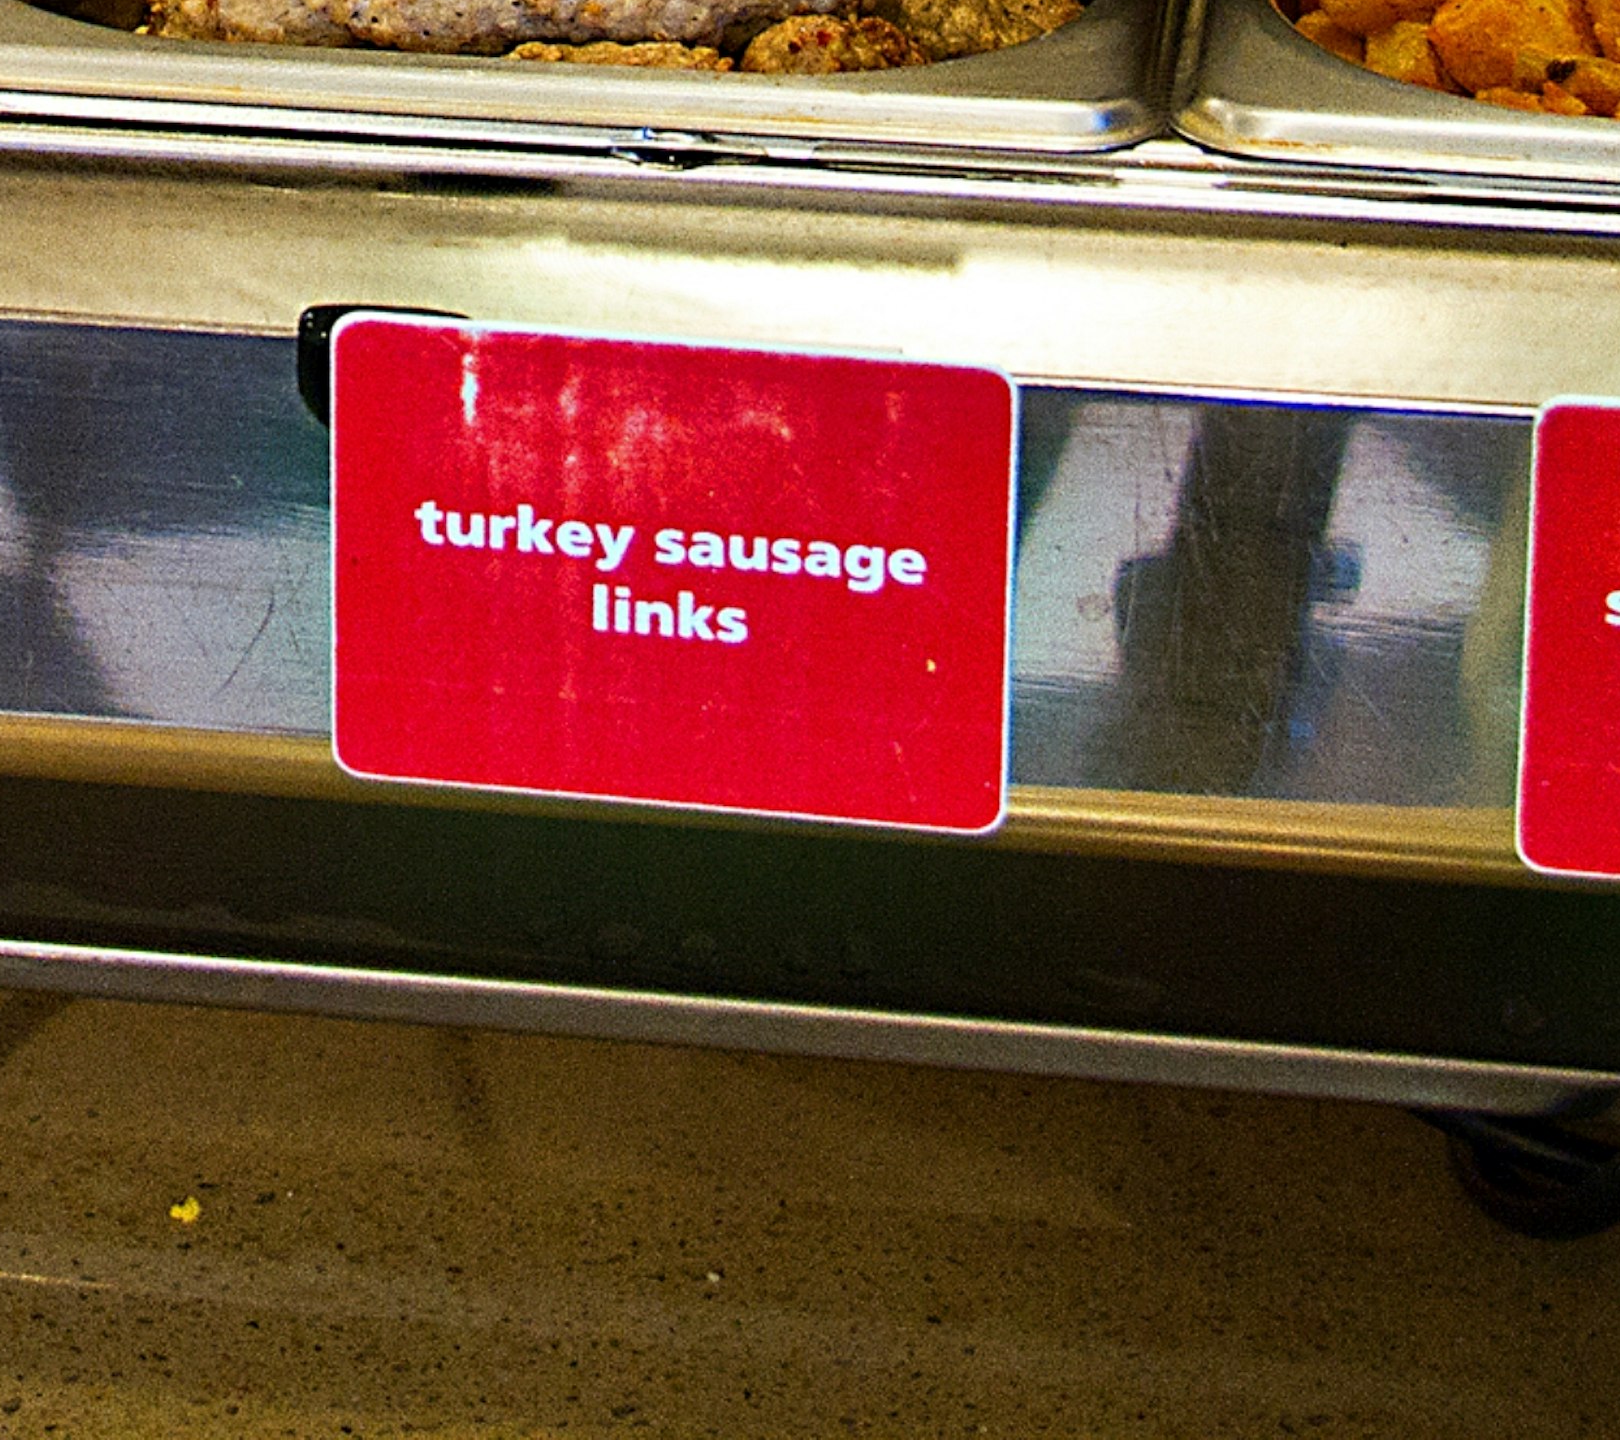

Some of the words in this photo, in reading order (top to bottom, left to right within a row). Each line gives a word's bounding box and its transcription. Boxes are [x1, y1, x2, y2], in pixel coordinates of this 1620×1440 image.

[415, 500, 634, 571] turkey
[654, 525, 928, 593] sausage
[591, 583, 748, 644] links
